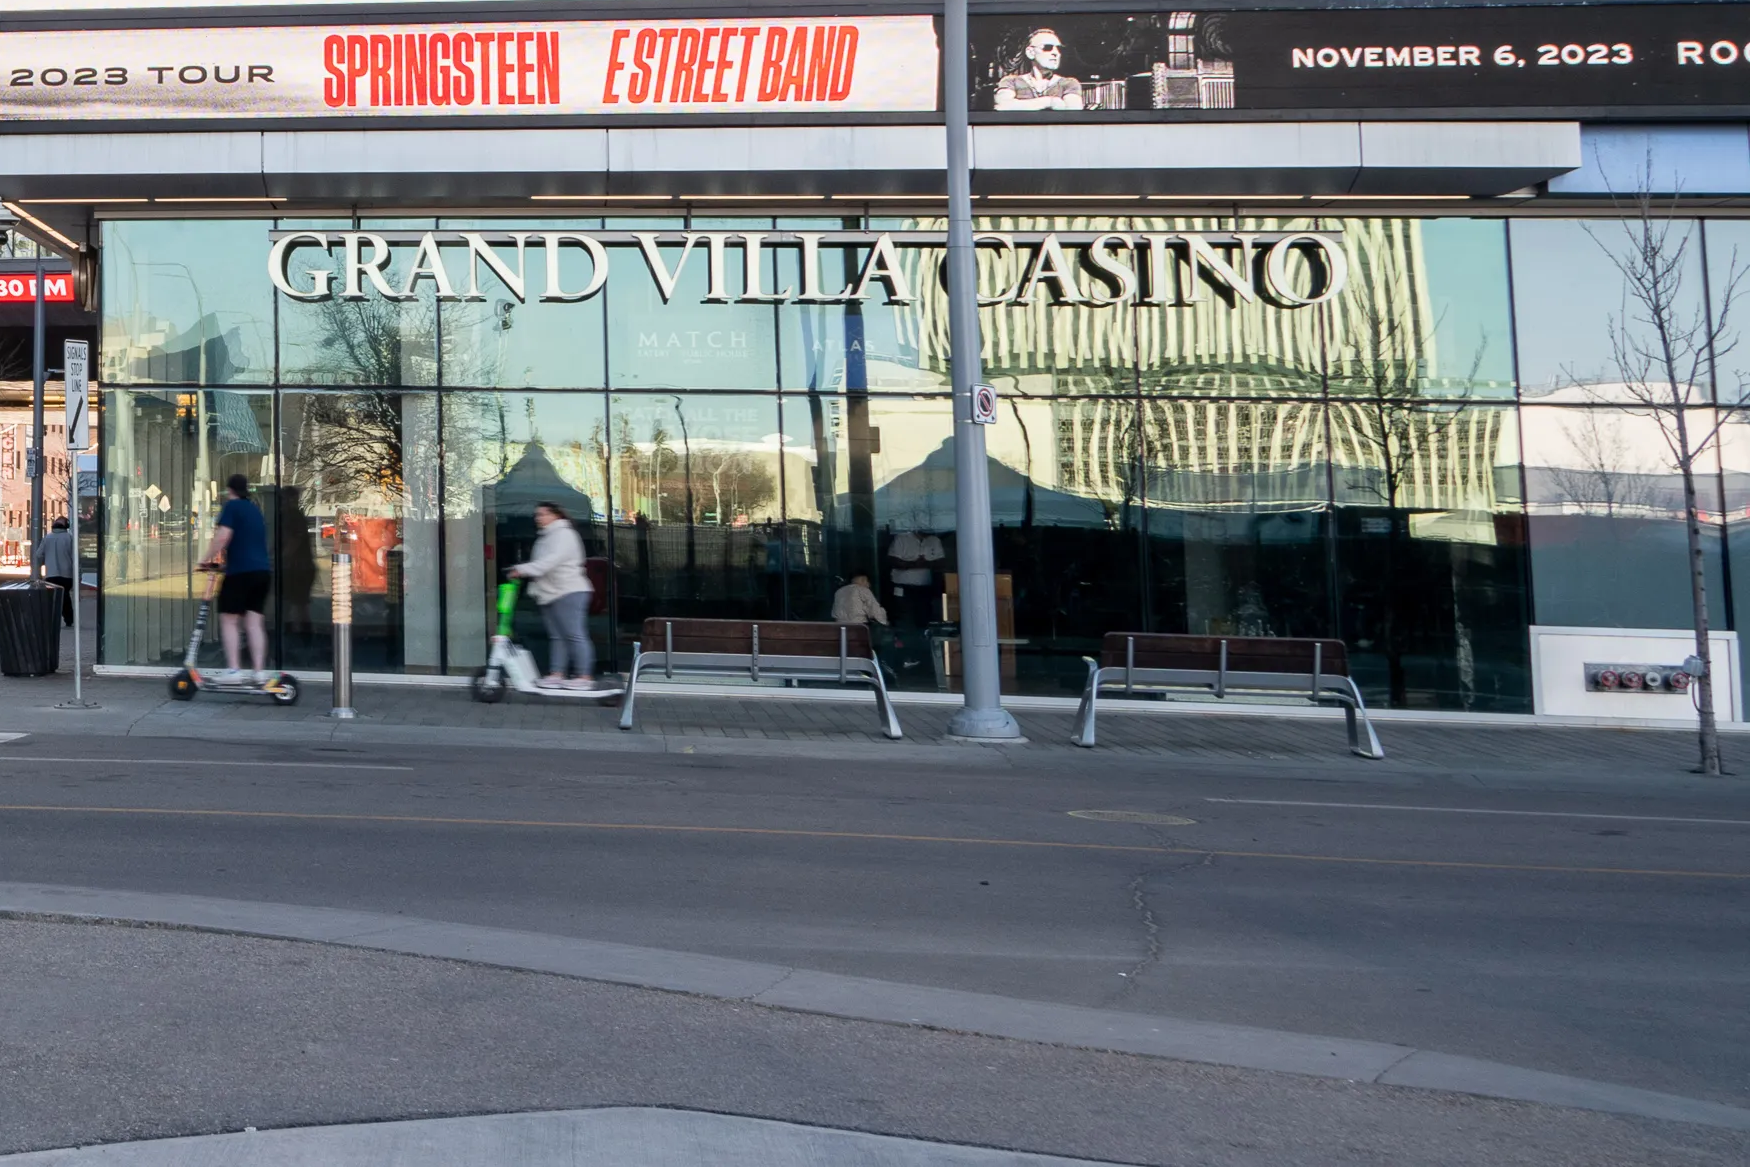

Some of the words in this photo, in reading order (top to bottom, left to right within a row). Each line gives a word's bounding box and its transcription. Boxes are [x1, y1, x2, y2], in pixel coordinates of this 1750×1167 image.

[602, 28, 630, 104] E
[627, 26, 761, 104] STREET
[757, 25, 859, 102] BAND
[1291, 45, 1482, 69] NOVEMBER
[1493, 44, 1527, 69] 6,
[1536, 42, 1635, 66] 2023
[1677, 40, 1750, 66] RO
[9, 66, 129, 87] 2023
[147, 64, 276, 85] TOUR
[323, 30, 561, 109] SPRINGSTEEN
[267, 231, 609, 303] GRAND
[630, 231, 919, 303] VILLA
[969, 232, 1349, 304] CASINO
[637, 331, 748, 348] MATCH
[811, 340, 875, 353] ATLAS
[66, 346, 87, 361] SIGNALS
[70, 362, 83, 376] STOP
[71, 379, 82, 393] LINE
